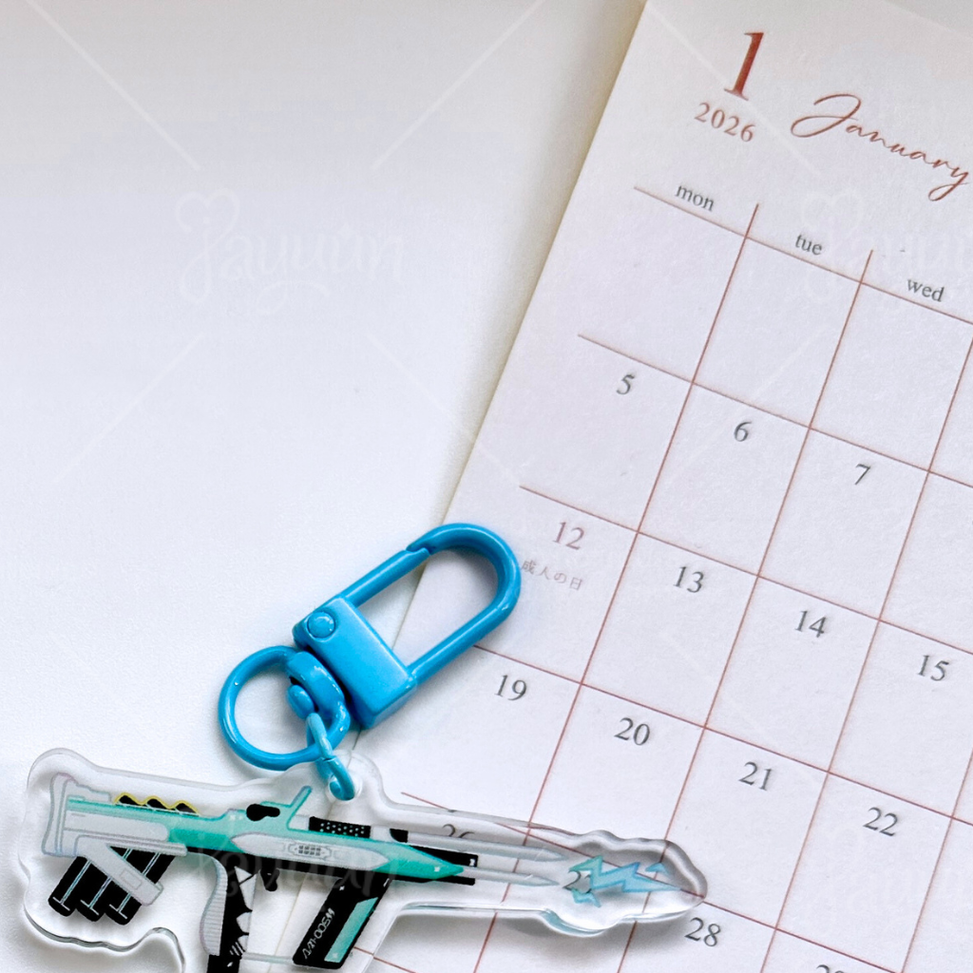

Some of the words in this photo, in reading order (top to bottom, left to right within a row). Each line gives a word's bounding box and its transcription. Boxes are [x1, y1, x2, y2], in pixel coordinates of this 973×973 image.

[724, 31, 765, 101] 1
[694, 102, 756, 142] 2026
[790, 93, 970, 202] January
[674, 184, 715, 212] mon
[794, 233, 823, 256] tue
[906, 277, 945, 302] wed
[616, 372, 636, 396] 5
[733, 420, 753, 443] 6
[853, 462, 872, 486] 7
[553, 521, 585, 551] 12
[521, 559, 584, 592] 成人の日
[673, 565, 706, 594] 13
[794, 609, 829, 639] 14
[917, 654, 950, 682] 15
[495, 674, 529, 702] 19
[614, 717, 652, 747] 20
[737, 761, 774, 792] 21
[862, 806, 900, 838] 22
[684, 917, 722, 948] 28
